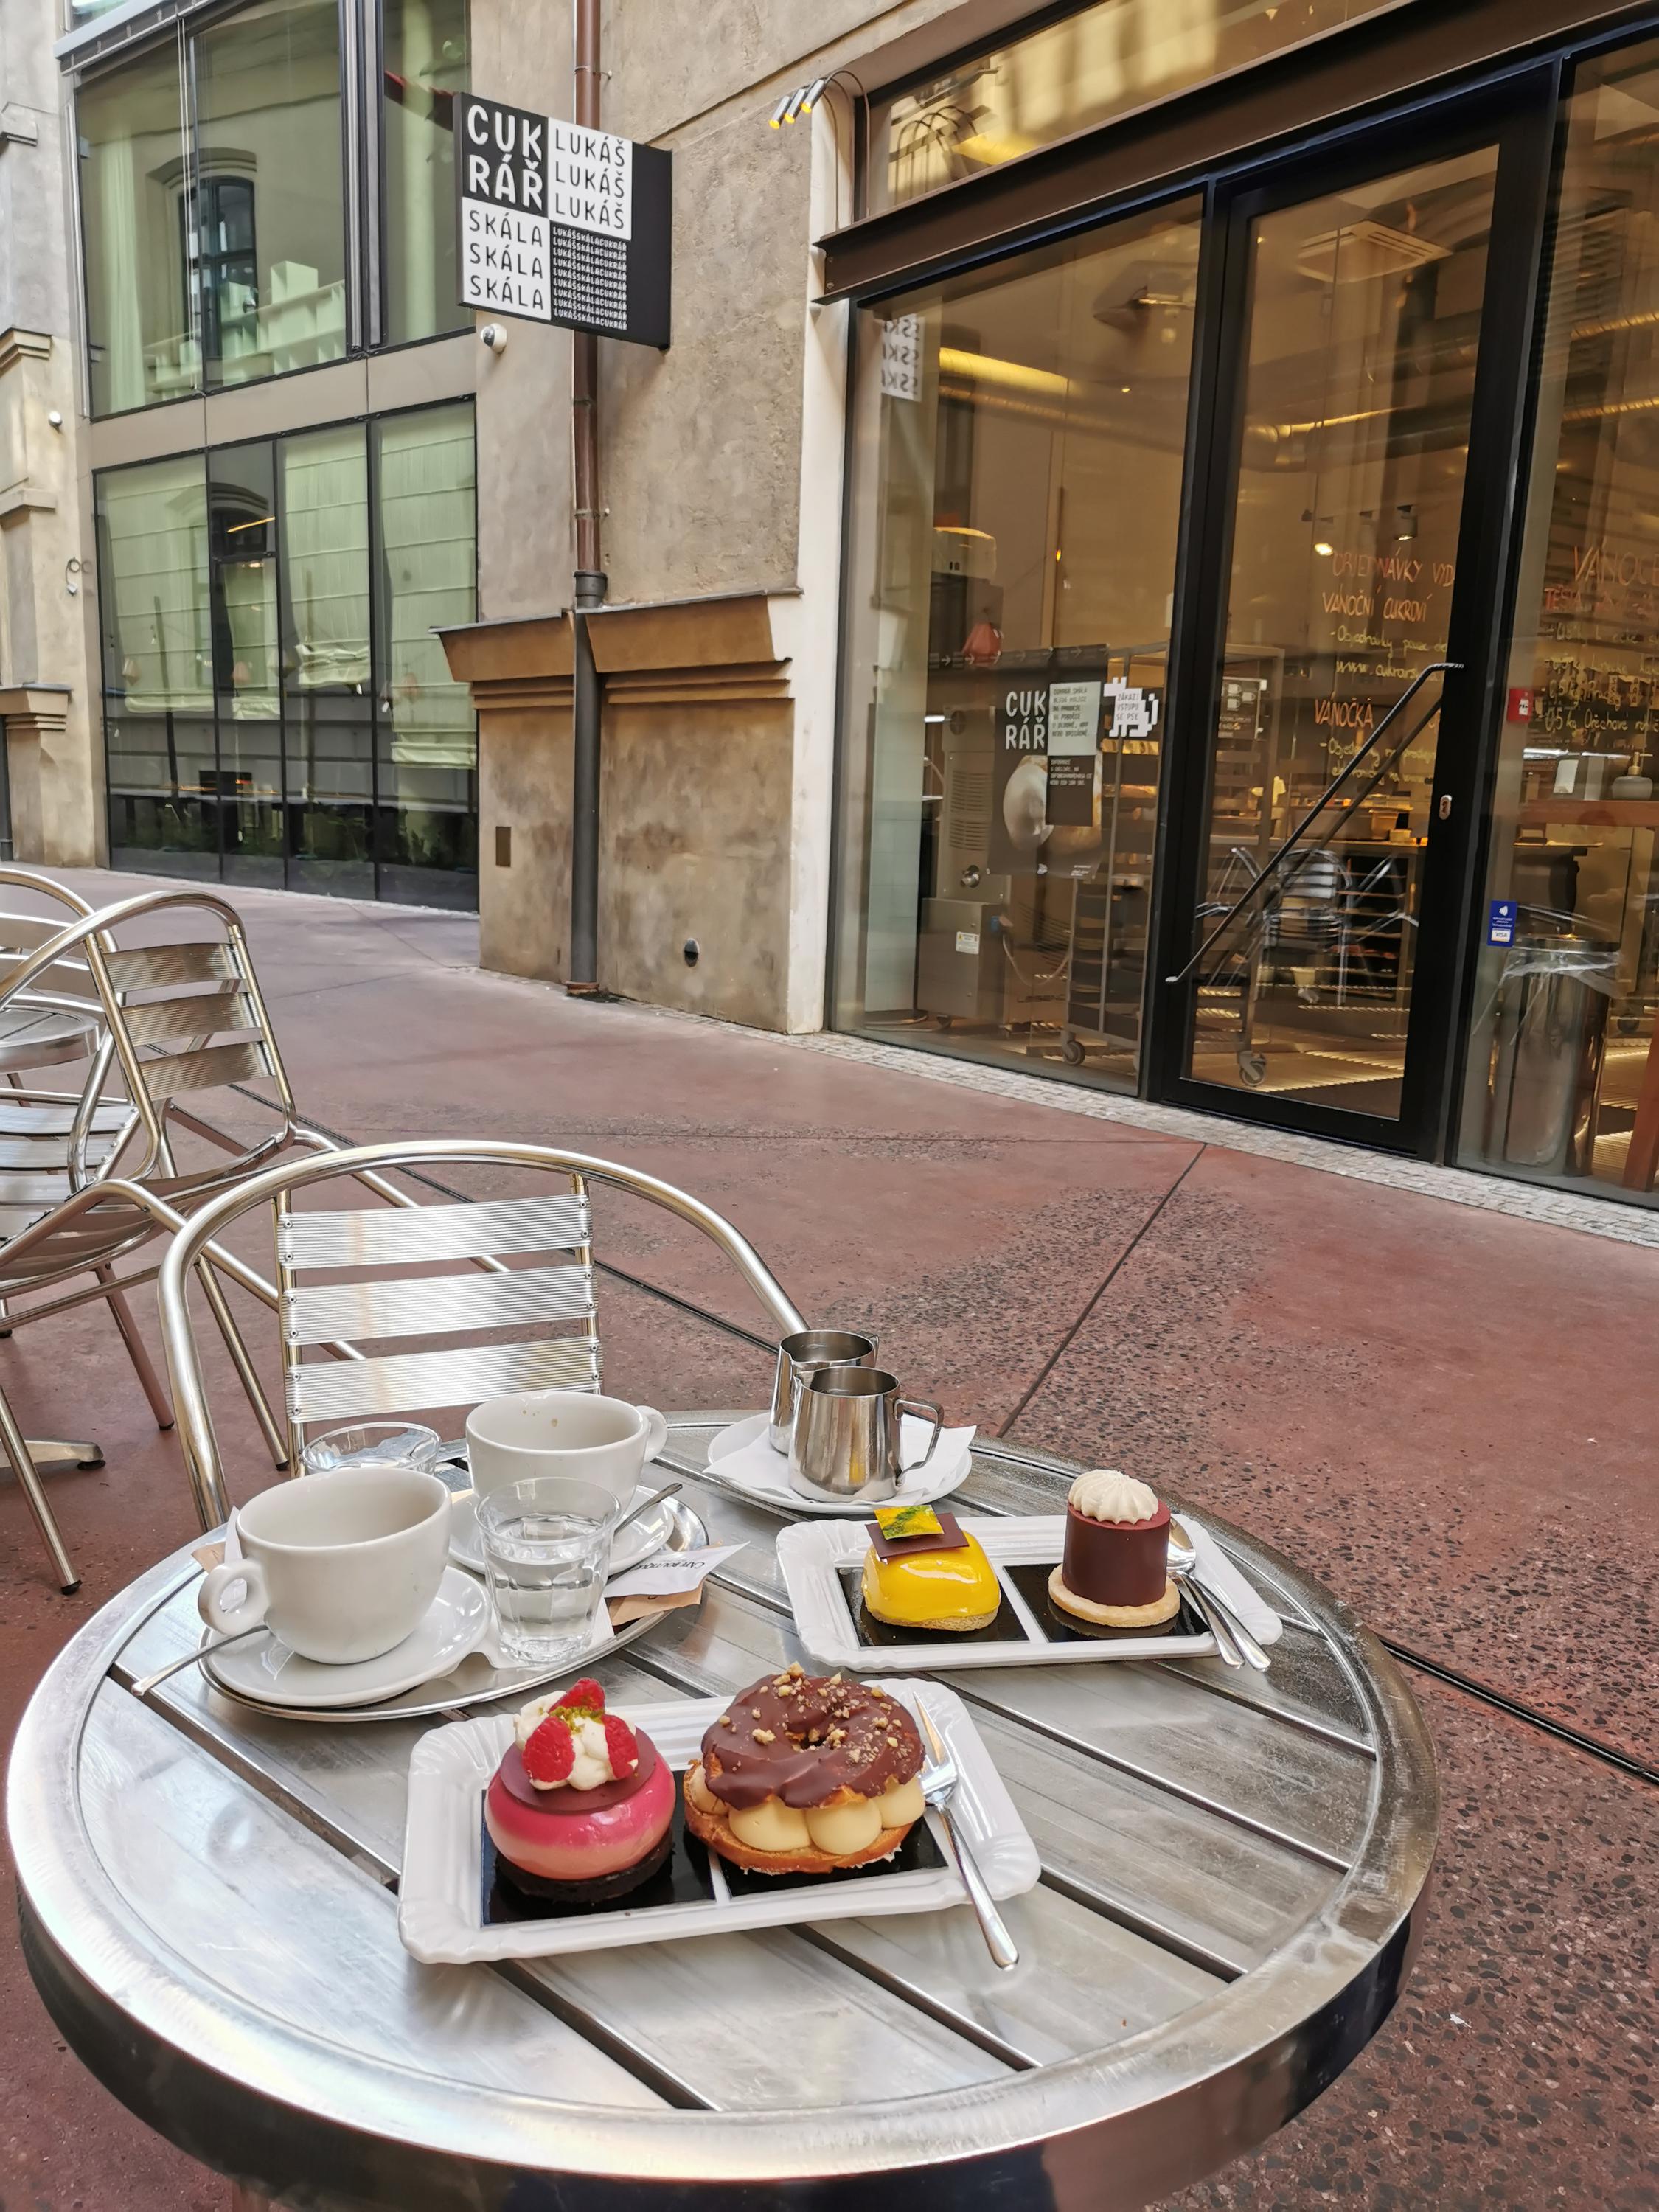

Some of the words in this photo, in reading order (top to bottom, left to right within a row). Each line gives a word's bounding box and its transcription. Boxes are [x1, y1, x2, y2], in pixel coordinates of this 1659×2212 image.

[467, 105, 543, 161] CUK
[554, 128, 625, 167] LUKÁŠ
[468, 153, 543, 211] RÁŘ
[554, 161, 625, 198] LUKÁŠ
[469, 210, 543, 248] SKÁLA
[554, 192, 625, 230] LUKÁŠ
[469, 242, 543, 279] SKÁLA
[470, 275, 543, 310] SKÁLA
[1005, 690, 1048, 717] CUK
[1005, 717, 1046, 750] RÁŘ
